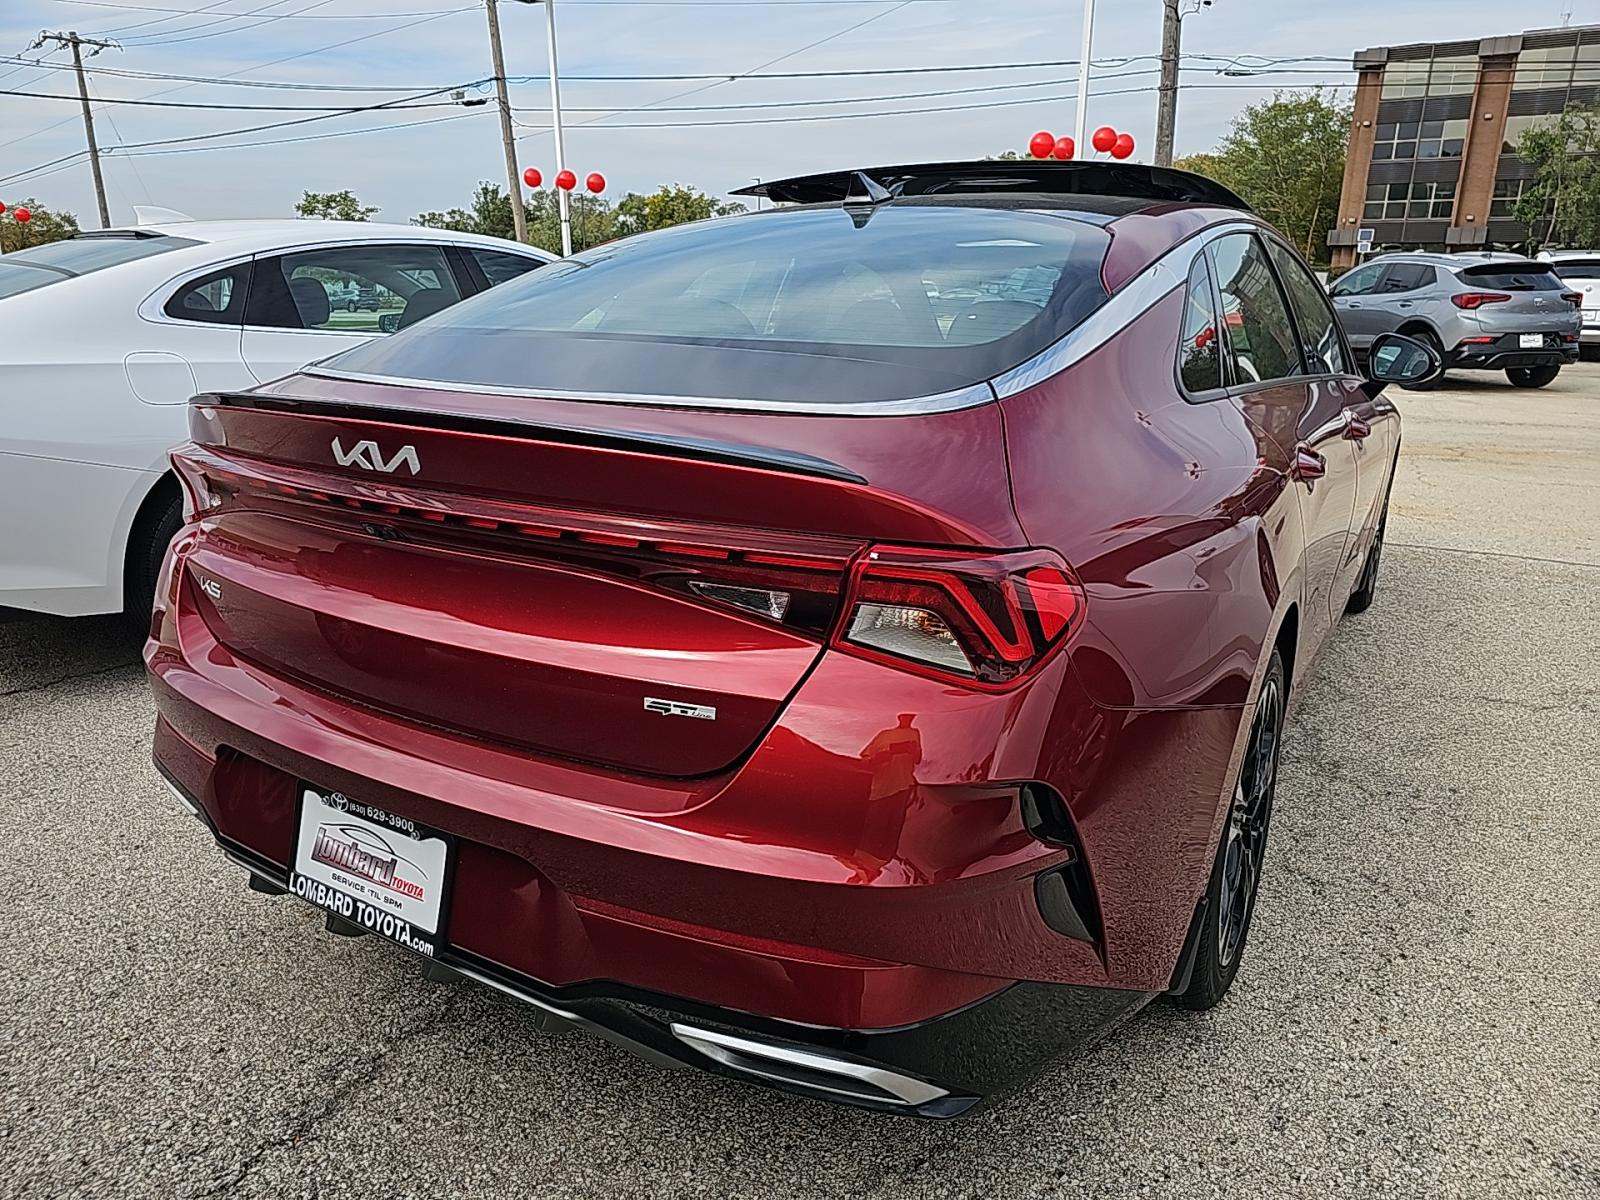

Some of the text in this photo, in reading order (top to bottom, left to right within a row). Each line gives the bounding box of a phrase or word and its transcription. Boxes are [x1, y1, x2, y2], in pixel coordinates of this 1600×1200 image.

[331, 436, 421, 475] KIA
[350, 803, 414, 832] (630) 629-3900
[289, 872, 353, 917] LOMBARD
[331, 873, 365, 893] SERVICE
[391, 877, 425, 899] TOYOTA
